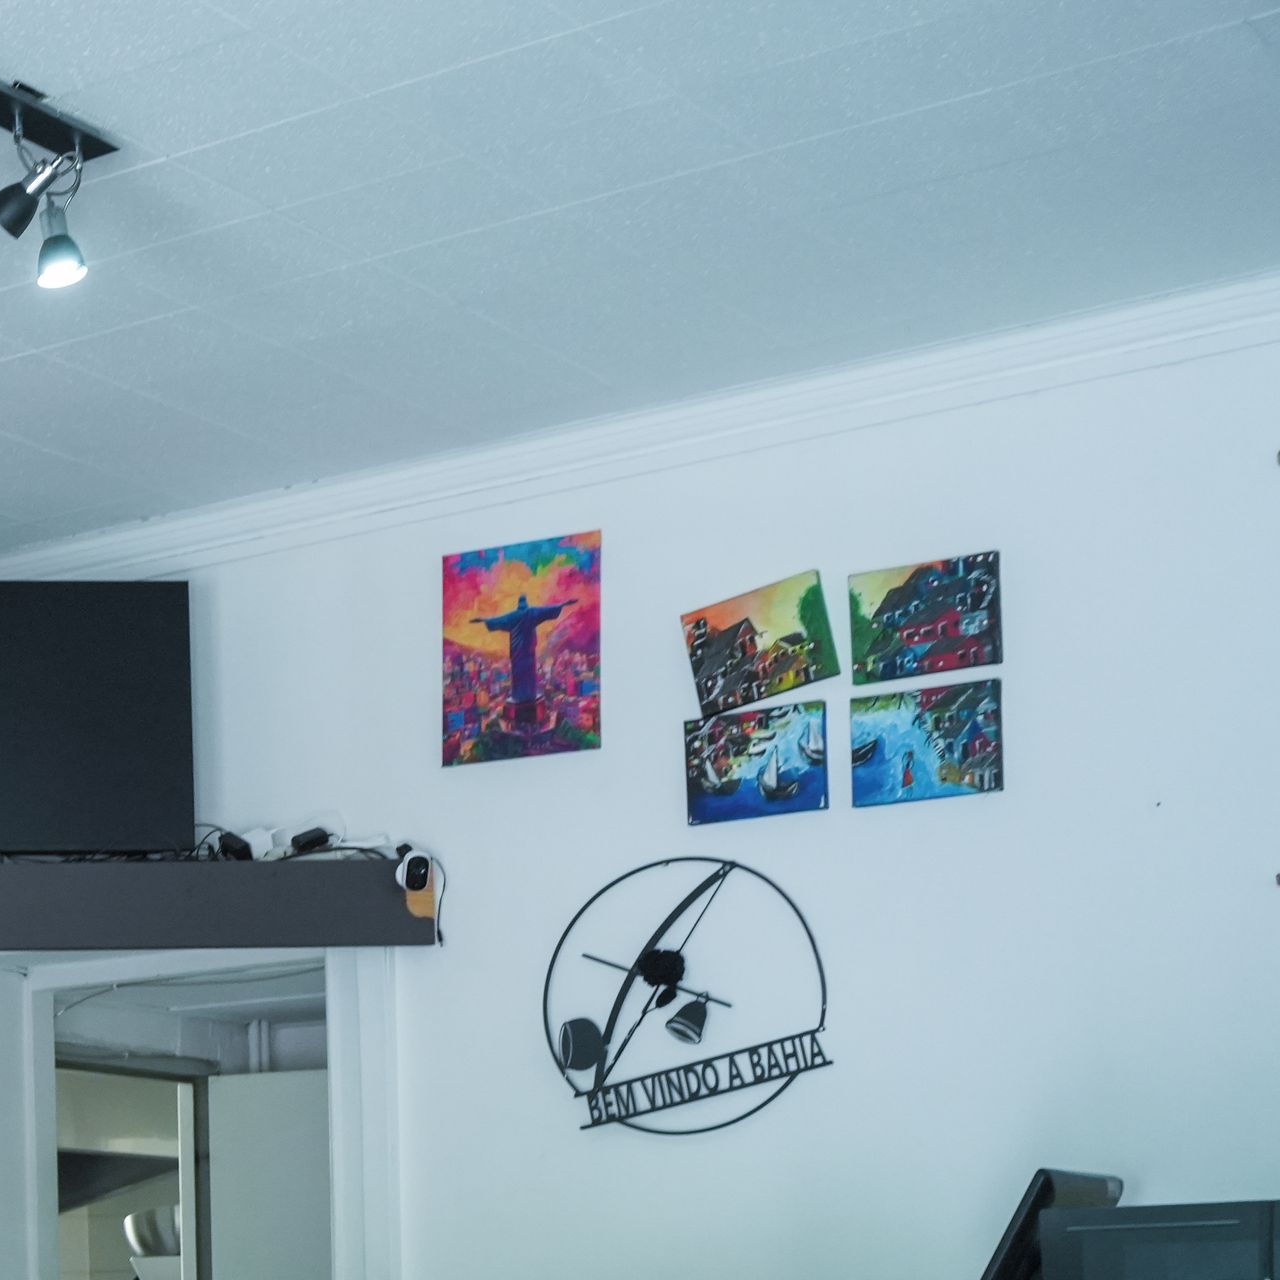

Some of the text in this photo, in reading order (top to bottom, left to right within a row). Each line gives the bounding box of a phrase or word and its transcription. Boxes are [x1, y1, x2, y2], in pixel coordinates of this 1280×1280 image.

[588, 1033, 828, 1125] BEM VINDO A BAHIA
